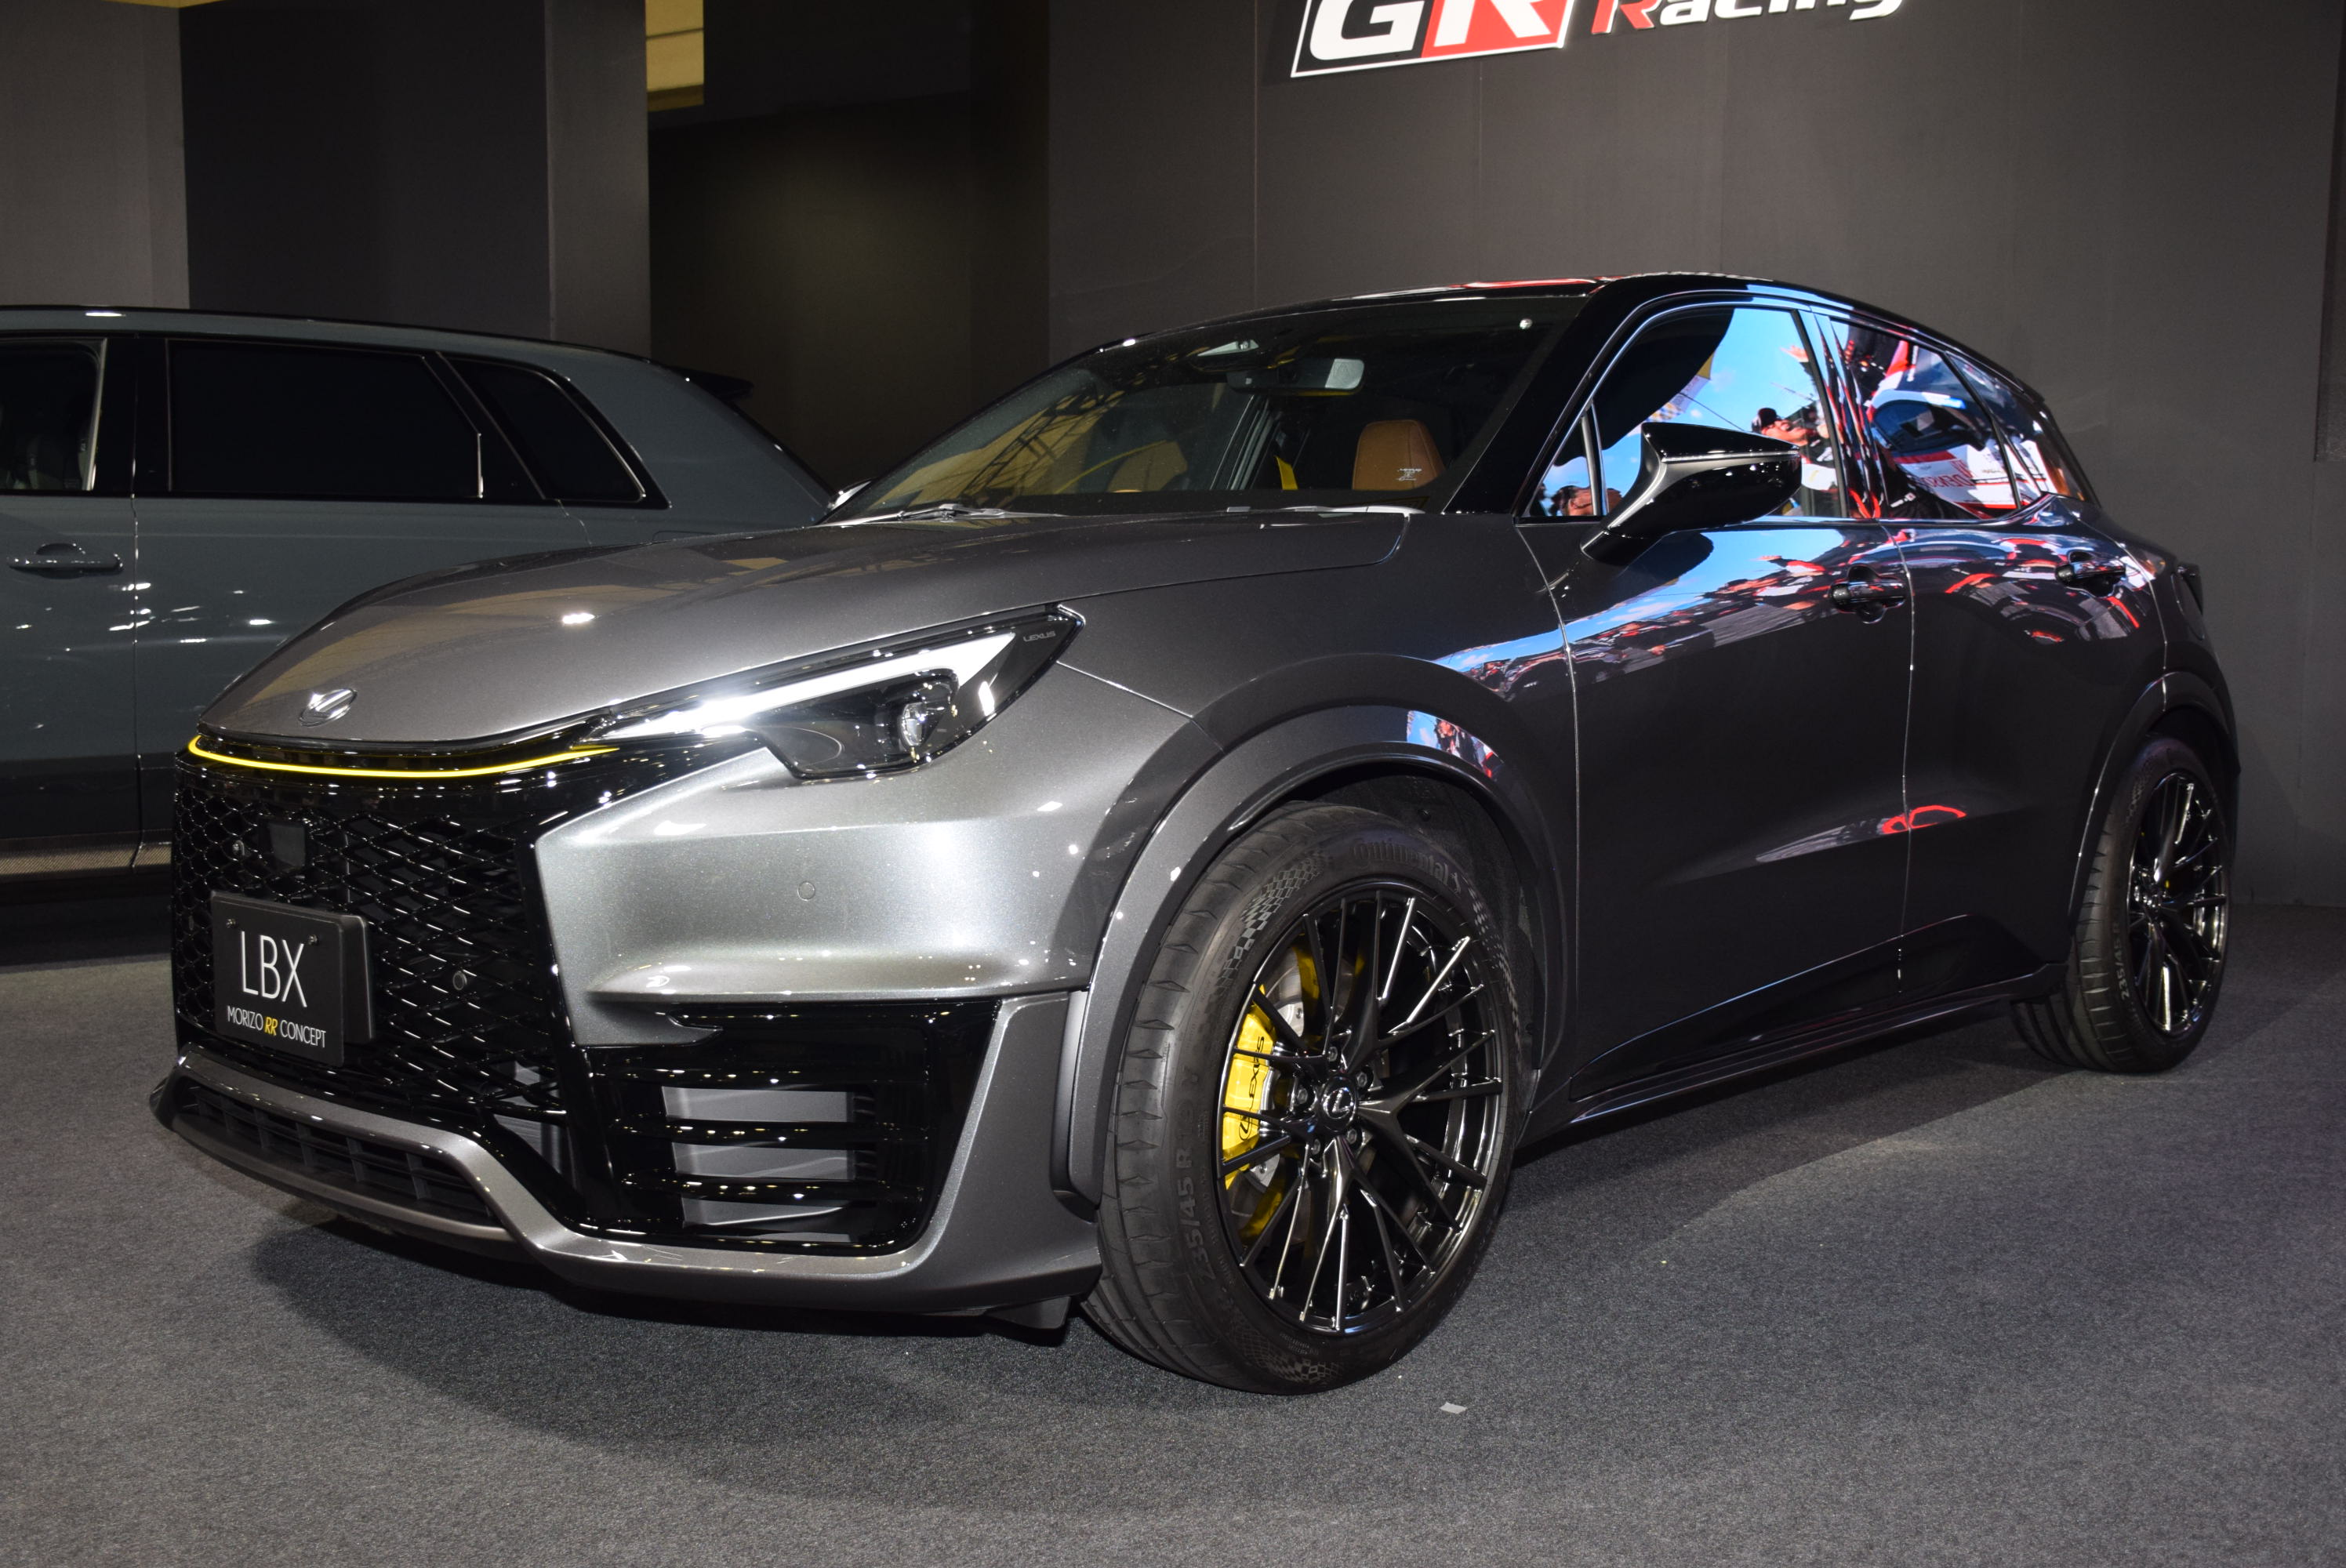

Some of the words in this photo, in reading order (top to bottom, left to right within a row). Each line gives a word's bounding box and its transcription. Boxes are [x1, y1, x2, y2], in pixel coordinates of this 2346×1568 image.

[1309, 0, 1552, 60] GR
[1592, 0, 1901, 34] Rac
[1022, 630, 1057, 642] LEXUS
[241, 931, 307, 1007] LBX
[227, 1005, 263, 1031] MORIZO
[264, 1016, 279, 1036] RR
[280, 1019, 327, 1048] CONCEPT
[1178, 1176, 1216, 1282] 235/45
